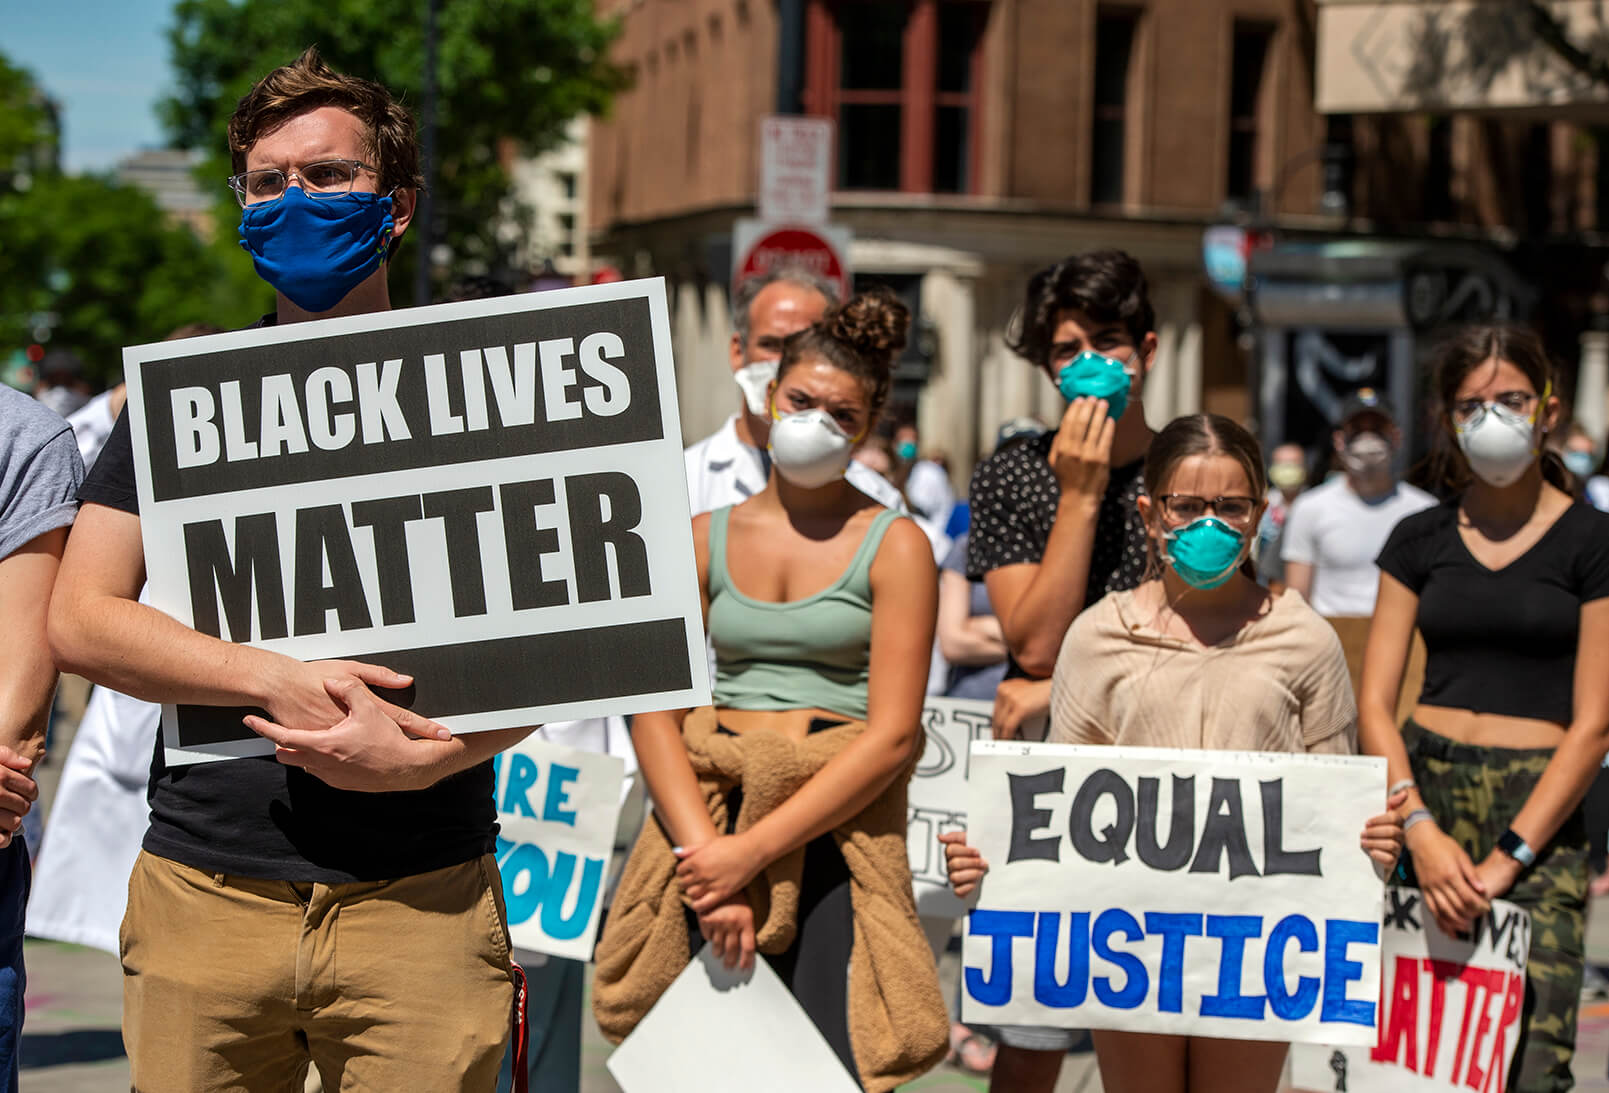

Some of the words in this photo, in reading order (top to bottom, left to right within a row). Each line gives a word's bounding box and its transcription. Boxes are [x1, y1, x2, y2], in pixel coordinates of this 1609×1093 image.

[170, 358, 412, 470] BLACK
[423, 332, 632, 437] LIVES
[182, 471, 652, 643] MATTER
[1006, 766, 1323, 881] EQUAL
[964, 908, 1379, 1028] JUSTICE
[1370, 955, 1524, 1093] ATTER
